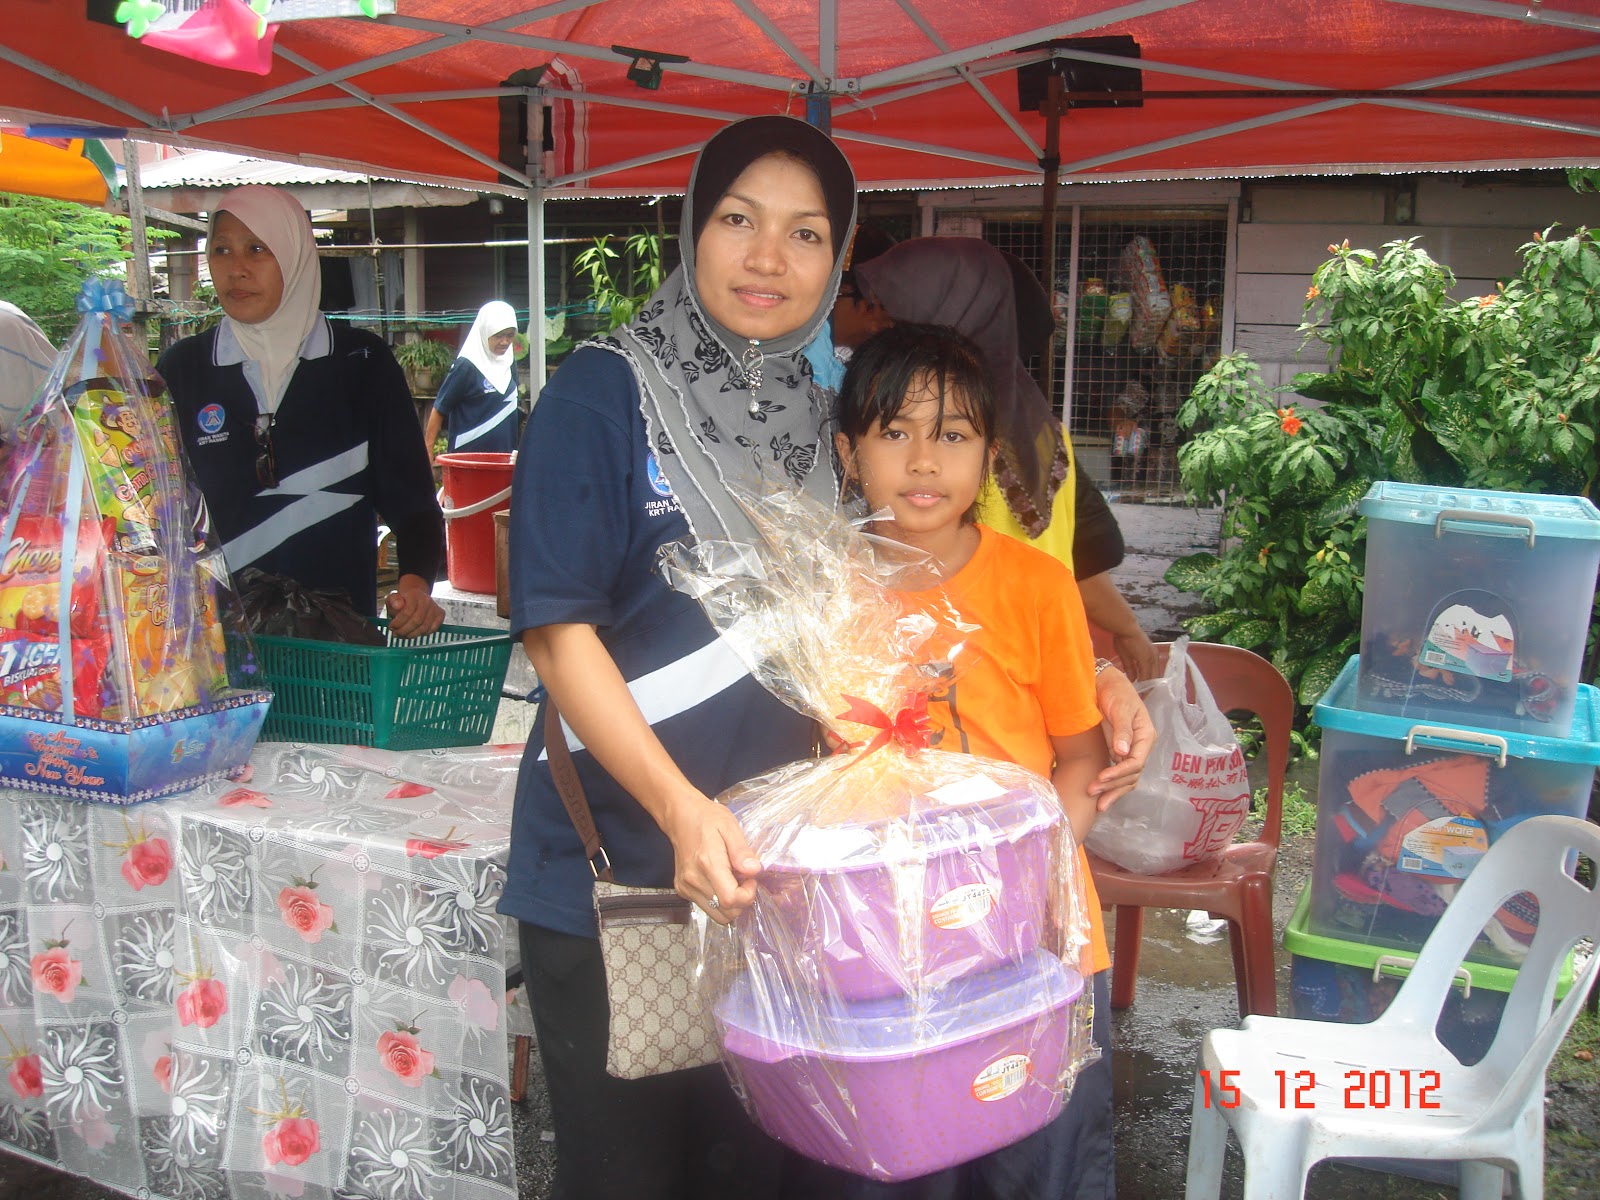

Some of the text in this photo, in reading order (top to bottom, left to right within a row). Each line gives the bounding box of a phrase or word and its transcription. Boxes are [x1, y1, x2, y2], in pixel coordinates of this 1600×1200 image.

[645, 500, 669, 509] JIRAN
[648, 508, 665, 517] KRT
[1171, 752, 1202, 774] DEN
[24, 758, 105, 786] New Year
